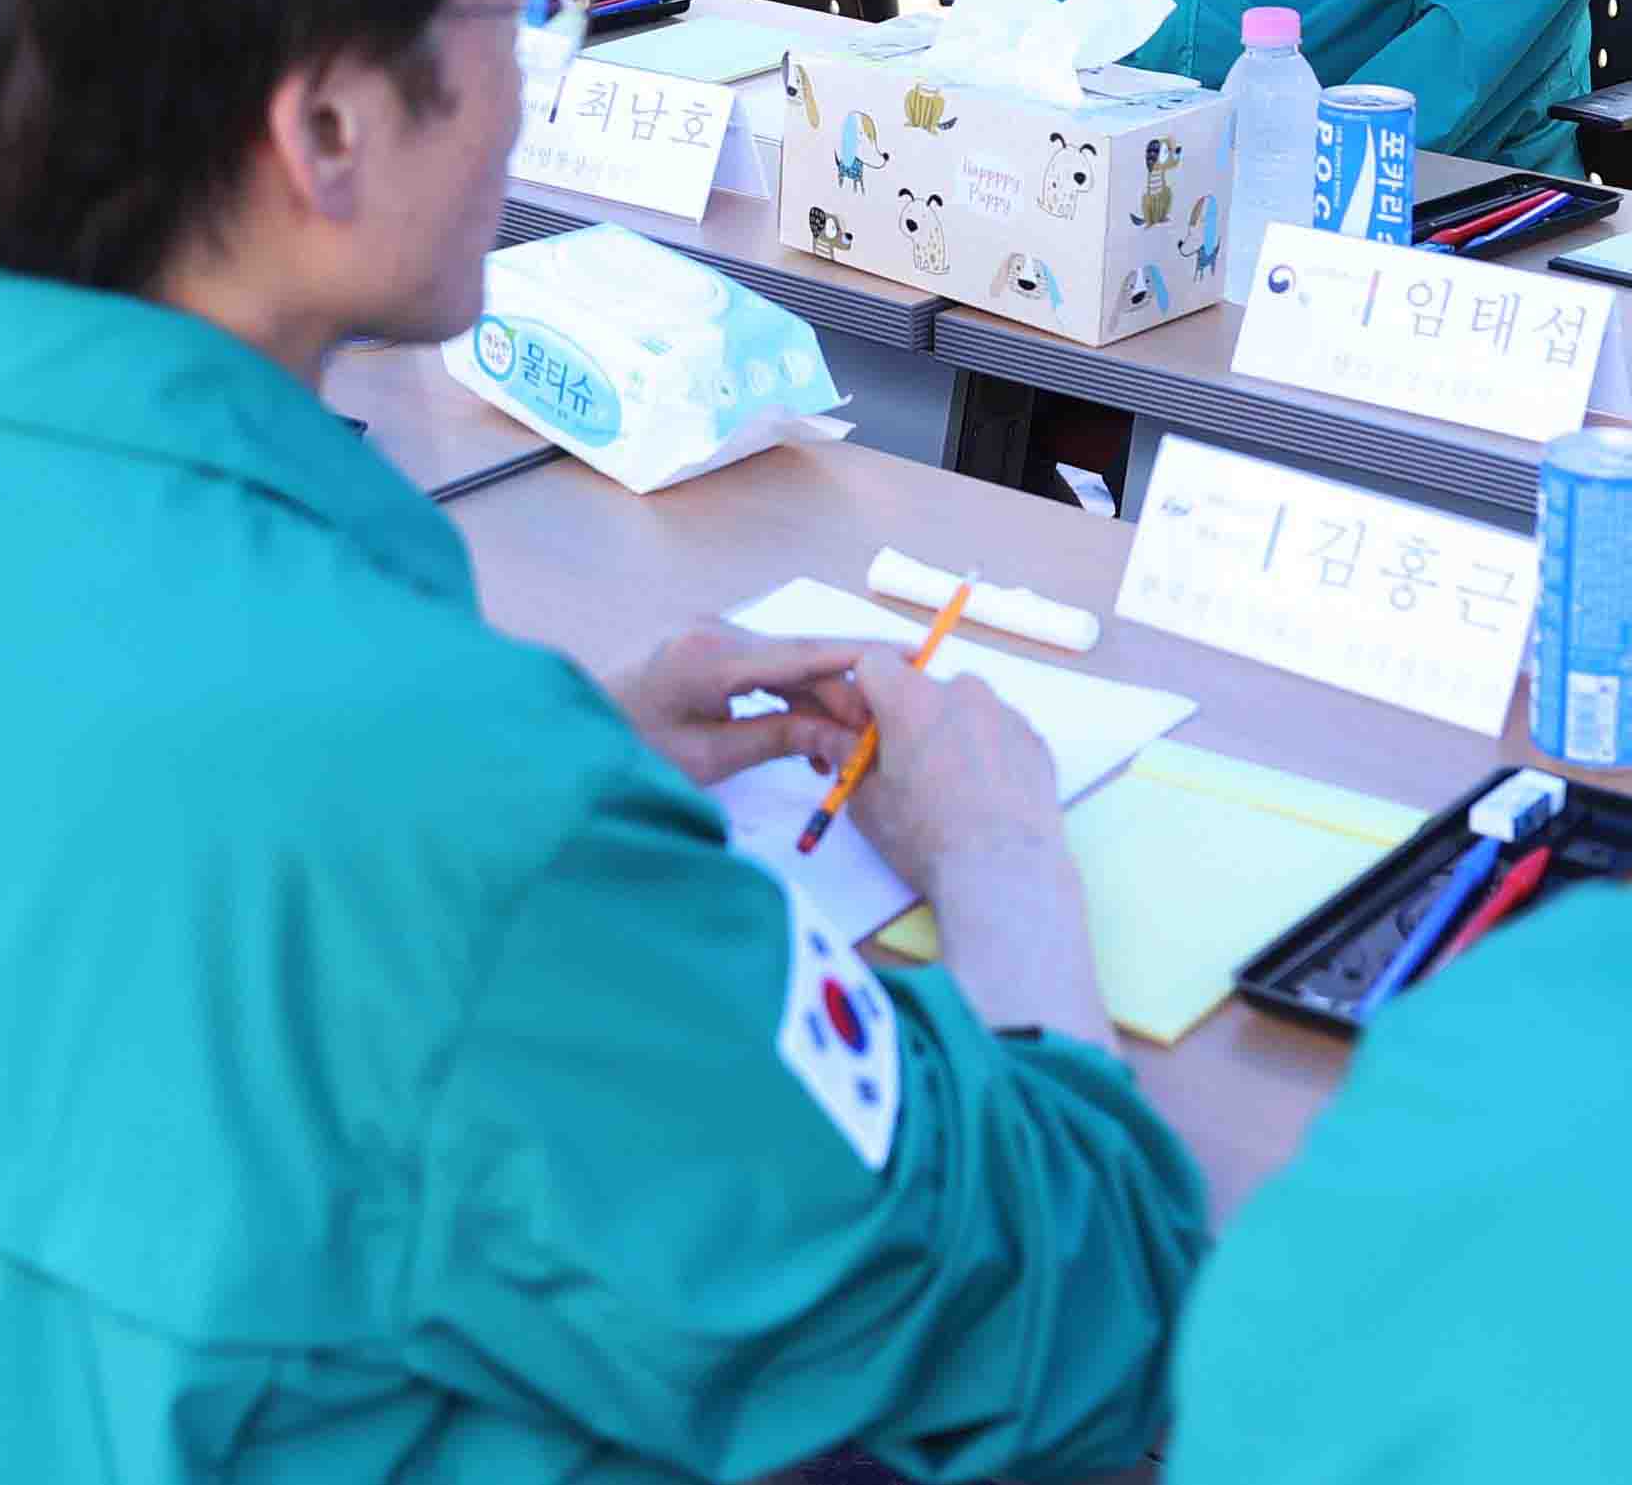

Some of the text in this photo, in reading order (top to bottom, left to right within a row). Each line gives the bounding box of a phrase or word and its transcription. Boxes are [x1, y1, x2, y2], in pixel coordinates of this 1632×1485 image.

[575, 80, 714, 150] 최남호
[1405, 276, 1588, 368] 임태섭
[520, 342, 594, 418] 물티슈
[1305, 518, 1519, 633] 김홍근
